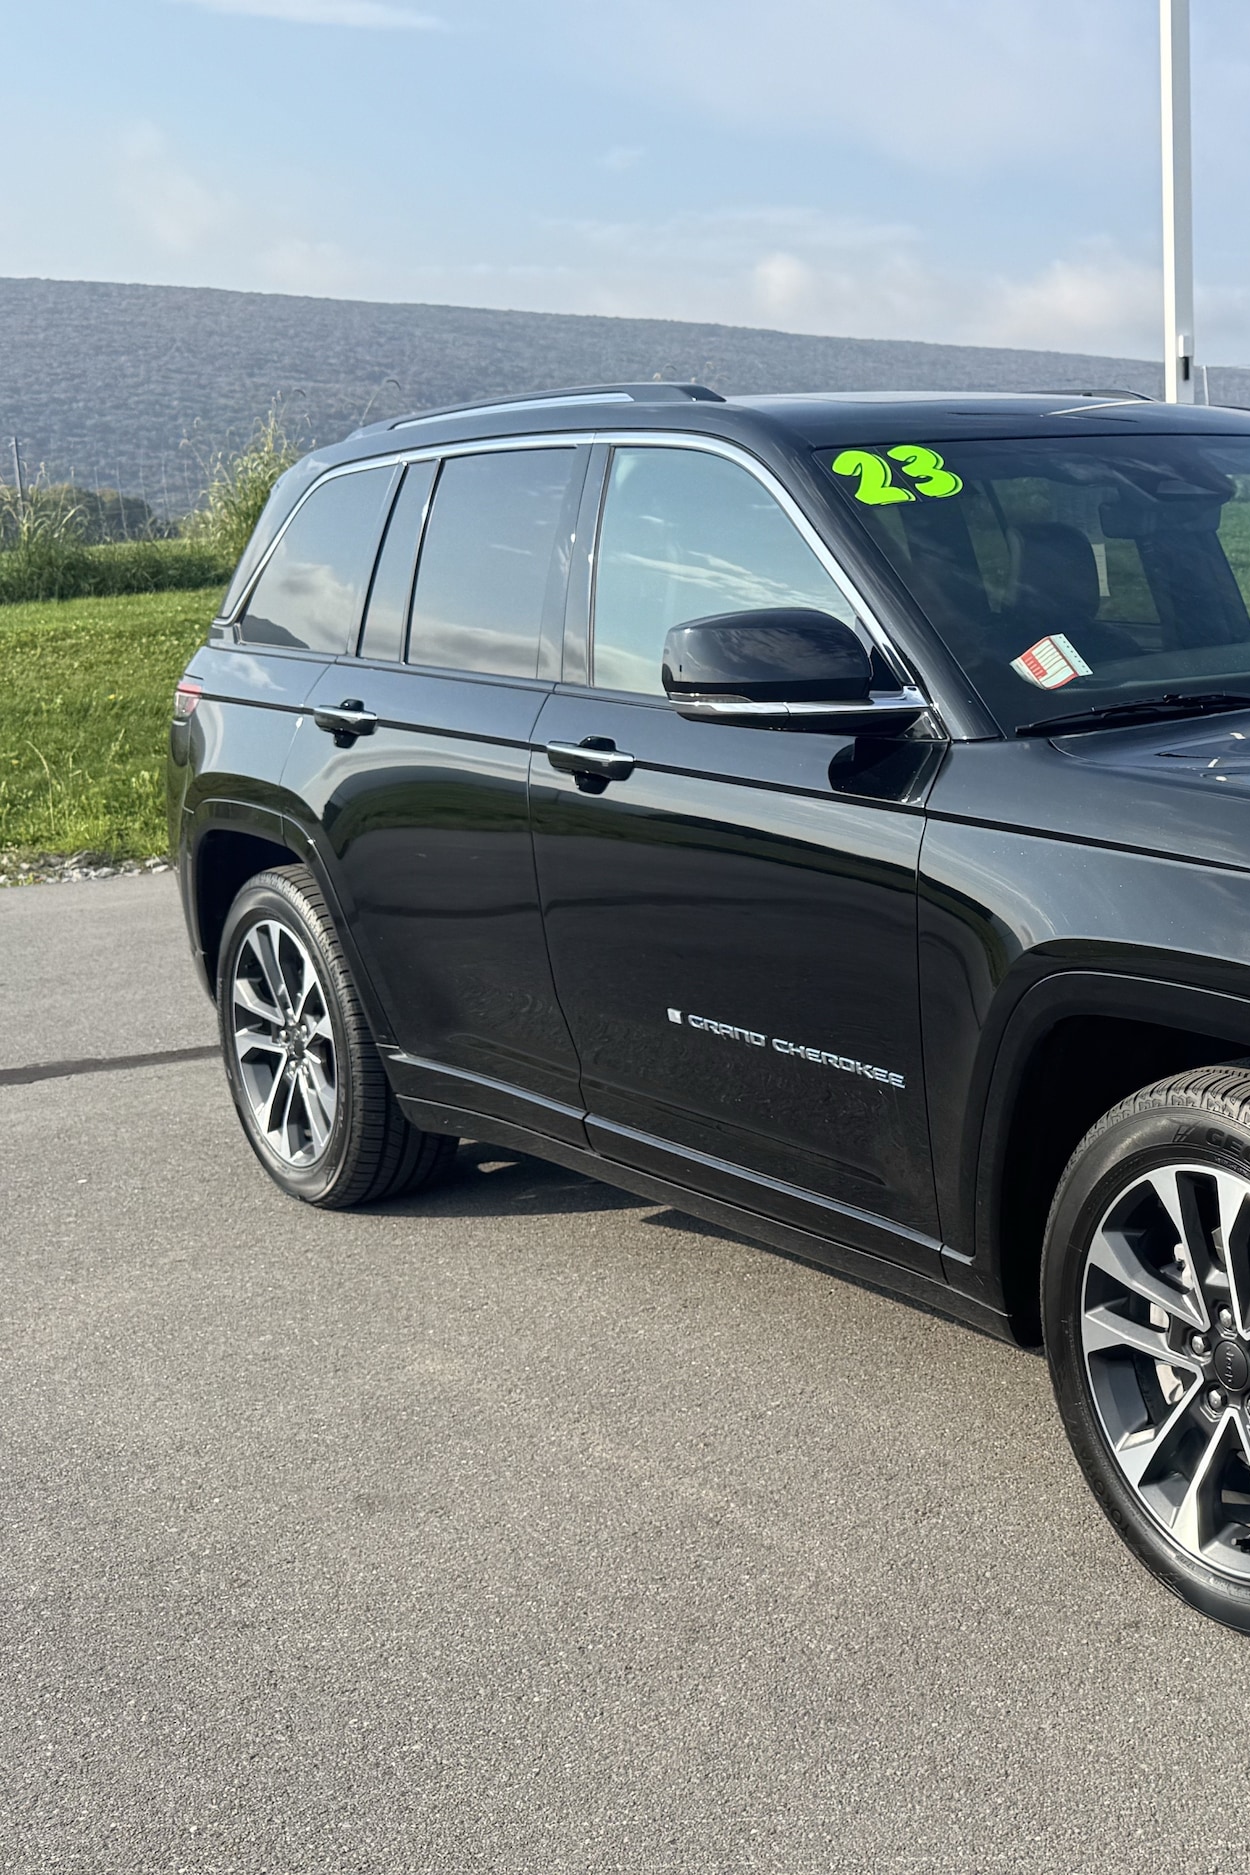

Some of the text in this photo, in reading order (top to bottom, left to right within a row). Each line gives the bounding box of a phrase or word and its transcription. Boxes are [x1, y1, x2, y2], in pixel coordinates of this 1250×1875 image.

[832, 444, 963, 505] 23
[688, 1014, 905, 1088] GRAND CHEROKEE
